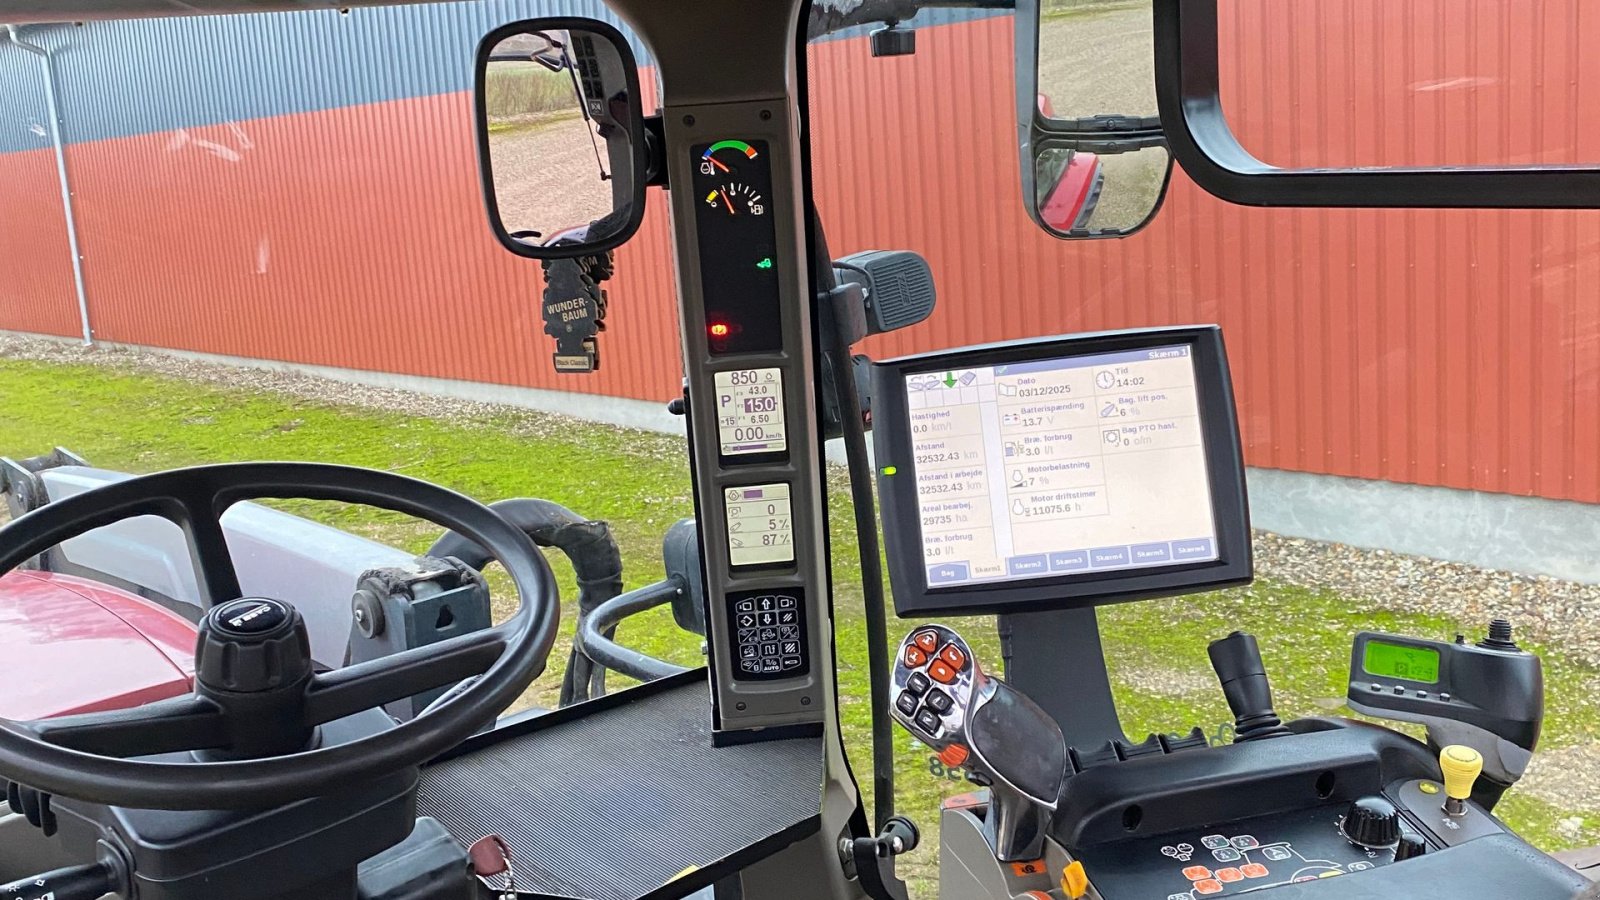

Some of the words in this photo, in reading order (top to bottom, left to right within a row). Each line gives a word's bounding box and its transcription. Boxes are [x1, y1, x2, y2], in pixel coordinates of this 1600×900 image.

[547, 297, 588, 315] WUNDER-
[562, 308, 588, 322] BAUM
[1148, 350, 1179, 359] Skærm
[731, 370, 758, 385] 850
[1017, 378, 1036, 386] Dato
[1116, 377, 1145, 388] 14:02
[748, 386, 767, 395] 43.0
[1019, 384, 1071, 398] 03/12/2025
[721, 395, 732, 408] P
[1118, 397, 1136, 405] Bag.
[1151, 394, 1168, 403] pos.
[1020, 402, 1085, 414] Batterispænding
[1120, 408, 1126, 416] 6
[750, 414, 770, 424] 6.50
[912, 410, 950, 420] Hastighed
[1023, 417, 1042, 427] 13.7
[1046, 416, 1055, 424] V
[913, 424, 928, 434] 0.0
[1122, 426, 1137, 434] Bag
[1139, 424, 1156, 432] PTO
[1158, 422, 1177, 430] hast.
[734, 427, 764, 441] 0.00
[1024, 436, 1042, 444] Bræ.
[1044, 433, 1073, 442] forbrug
[916, 442, 945, 451] Afstand
[1124, 438, 1130, 446] 0
[916, 452, 960, 464] 32532.43
[963, 450, 978, 459] km
[1026, 447, 1040, 456] 3.0
[1028, 461, 1090, 474] Motorbelastning
[918, 472, 948, 482] Afstand
[954, 470, 983, 479] arbejde
[1029, 478, 1035, 486] 7
[920, 482, 963, 495] 32532.43
[967, 481, 982, 490] km
[1030, 495, 1054, 503] Motor
[1056, 491, 1096, 500] driftstimer
[768, 504, 776, 515] 0
[922, 504, 942, 512] Areal
[943, 502, 973, 510] bearbej.
[1032, 504, 1071, 516] 11075.6
[1075, 502, 1082, 512] h
[769, 519, 777, 530] 5
[779, 518, 790, 529] %
[923, 515, 952, 526] 29735
[762, 534, 778, 546] 87
[780, 533, 791, 545] %
[944, 533, 973, 542] forbrug
[926, 548, 941, 557] 3.0
[941, 570, 955, 578] Bag
